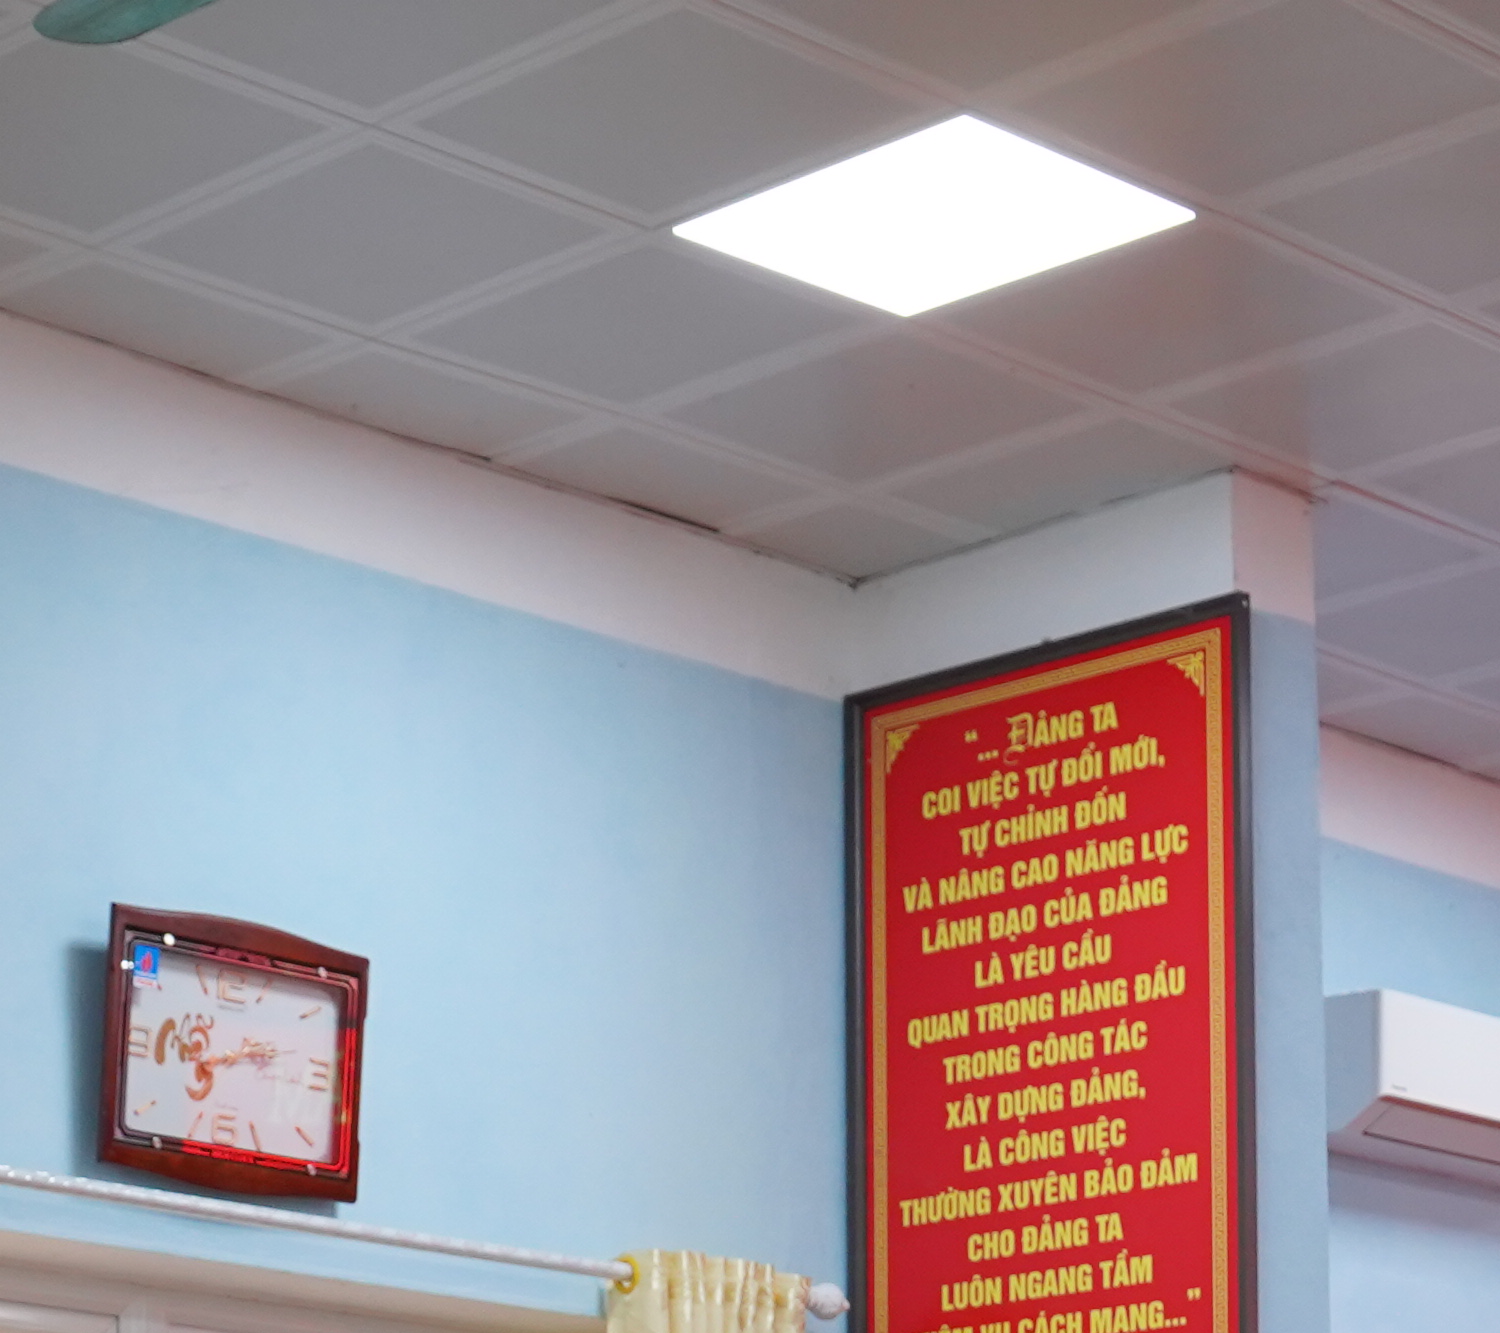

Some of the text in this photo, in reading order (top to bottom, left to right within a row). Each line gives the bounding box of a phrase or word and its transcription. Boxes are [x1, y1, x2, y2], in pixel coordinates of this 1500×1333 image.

[1003, 701, 1119, 766] ĐẢNG TA
[922, 734, 1166, 821] COI VIỆC TỰ ĐỔI MỚI,
[959, 785, 1128, 859] TỰ CHỈNH ĐỐN
[902, 823, 1190, 914] VÀ NÂNG CAO NĂNG LỰC
[921, 874, 1169, 955] LÃNH ĐẠO CỦA ĐẢNG
[974, 927, 1112, 990] LÀ YÊU CẦU
[907, 959, 1187, 1050] QUAN TRỌNG HÀNG ĐẦU
[943, 1017, 1149, 1085] TRONG CÔNG TÁC
[945, 1066, 1147, 1131] XÂY DỰNG ĐẢNG,
[963, 1115, 1127, 1173] LÀ CÔNG VIỆC
[899, 1146, 1199, 1228] THƯỜNG XUYÊN BẢO ĐẢM
[966, 1211, 1125, 1263] CHO ĐẢNG TA
[941, 1248, 1154, 1313] LUÔN NGANG TẦM
